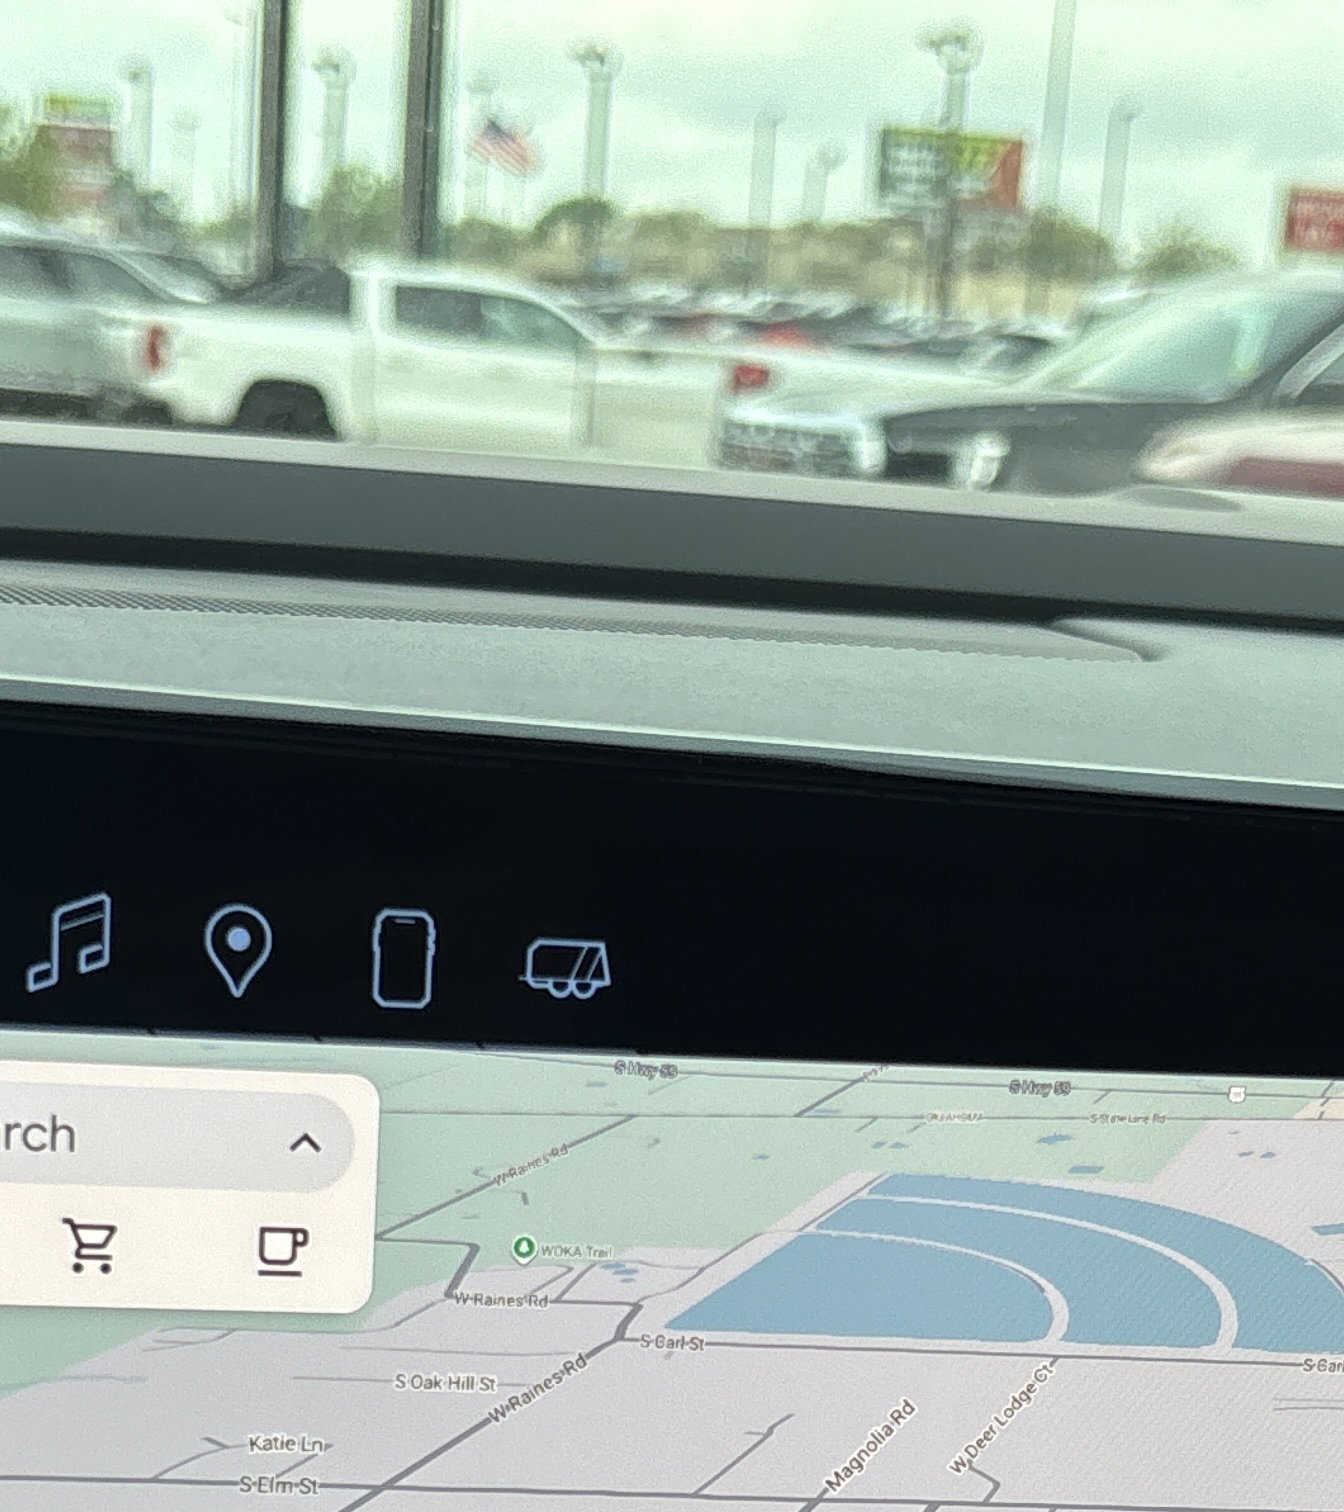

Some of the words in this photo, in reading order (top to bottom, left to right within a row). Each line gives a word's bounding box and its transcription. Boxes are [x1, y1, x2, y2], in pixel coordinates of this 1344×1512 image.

[541, 1245, 582, 1258] WOKA
[395, 1374, 405, 1391] S
[410, 1374, 443, 1391] Oak
[447, 1374, 477, 1392] Hill
[481, 1375, 496, 1392] St
[488, 1403, 509, 1424] W
[507, 1371, 563, 1411] Raines
[562, 1352, 587, 1375] Rd
[248, 1434, 296, 1453] Katie
[302, 1435, 323, 1453] Ln
[826, 1424, 892, 1492] Magnolia
[890, 1399, 916, 1424] Rd
[239, 1476, 252, 1494] S
[257, 1476, 293, 1494] Elm
[298, 1477, 319, 1495] St
